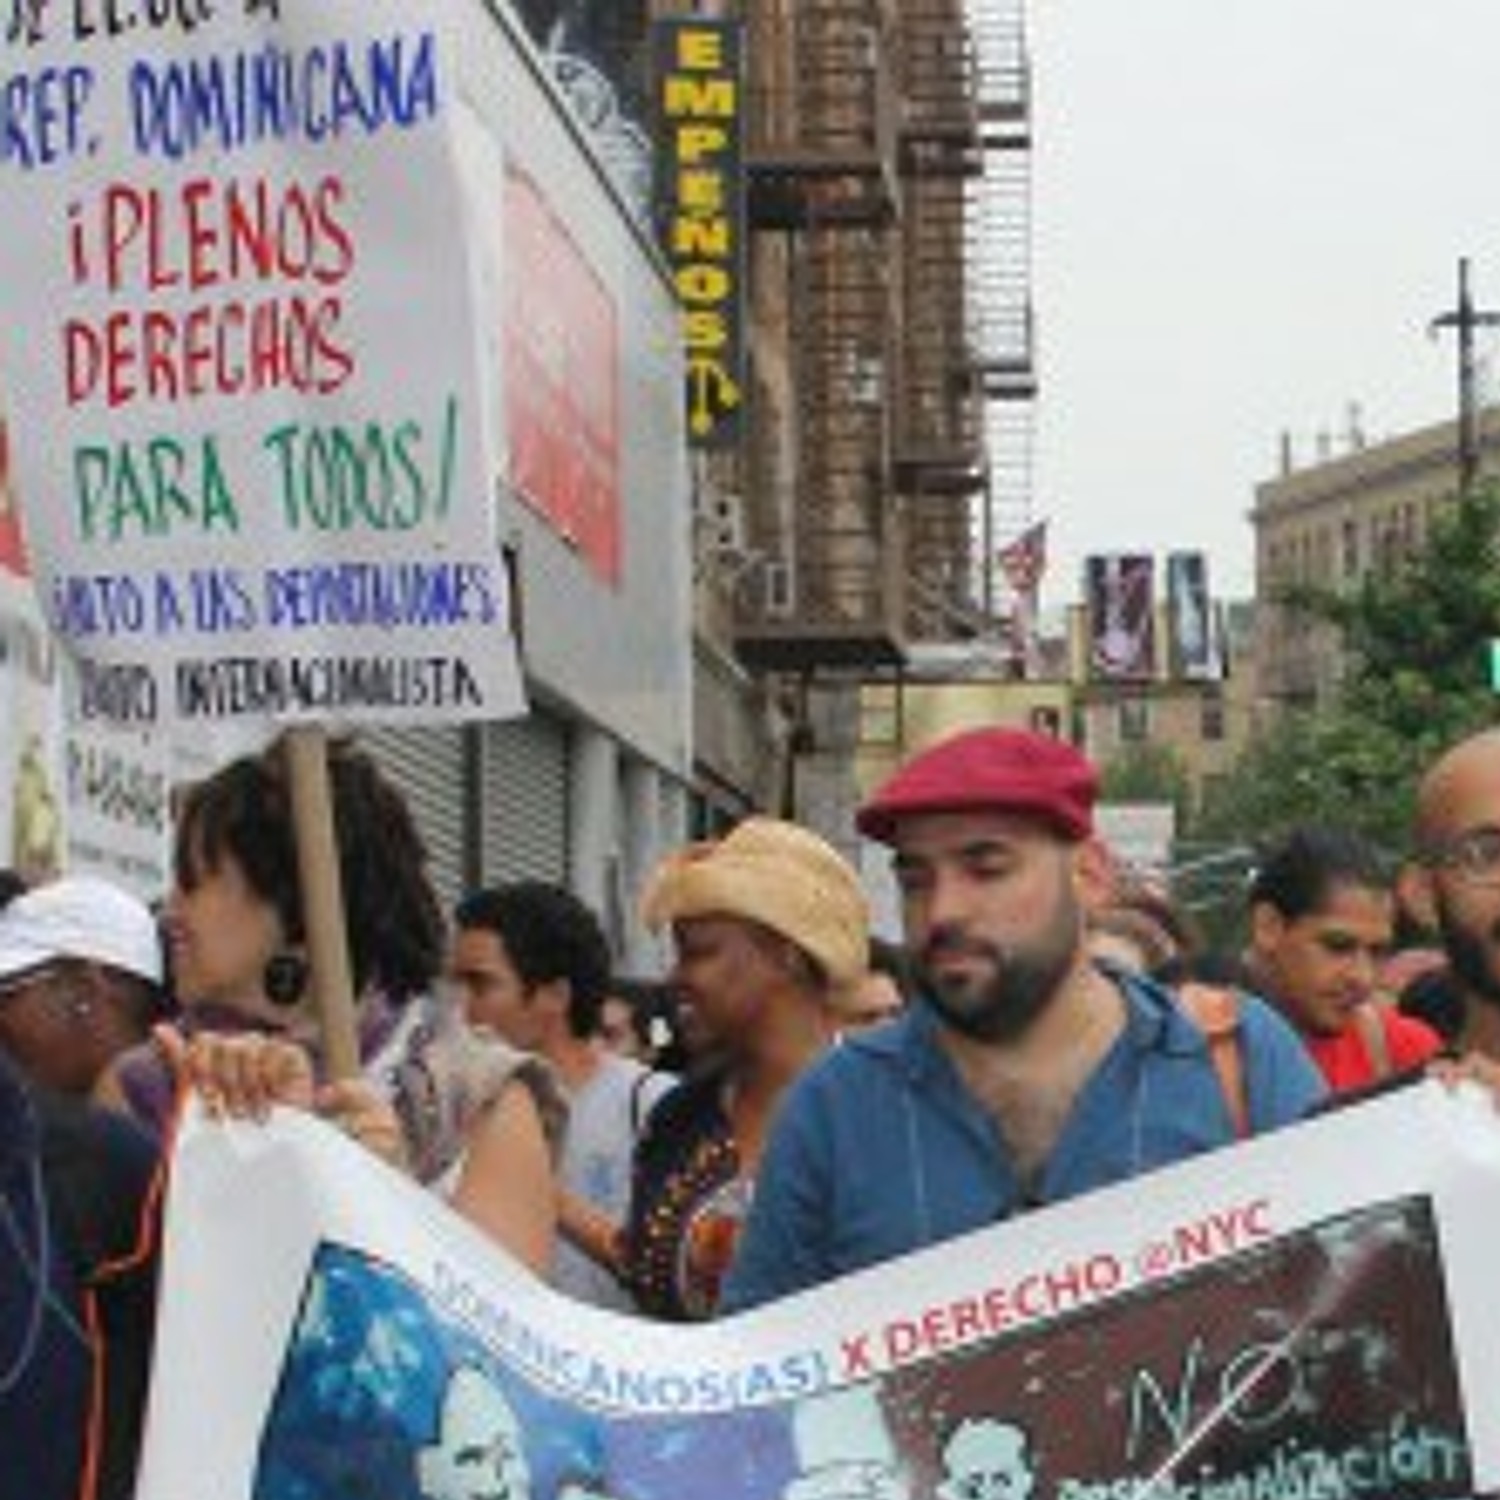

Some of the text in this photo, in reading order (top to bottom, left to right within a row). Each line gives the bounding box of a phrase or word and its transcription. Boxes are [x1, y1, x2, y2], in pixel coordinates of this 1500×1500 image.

[65, 296, 356, 406] DERECHOS
[74, 434, 240, 541] PARA
[154, 572, 184, 635] A
[840, 1333, 870, 1378] X
[884, 1252, 1124, 1362] DERECHO
